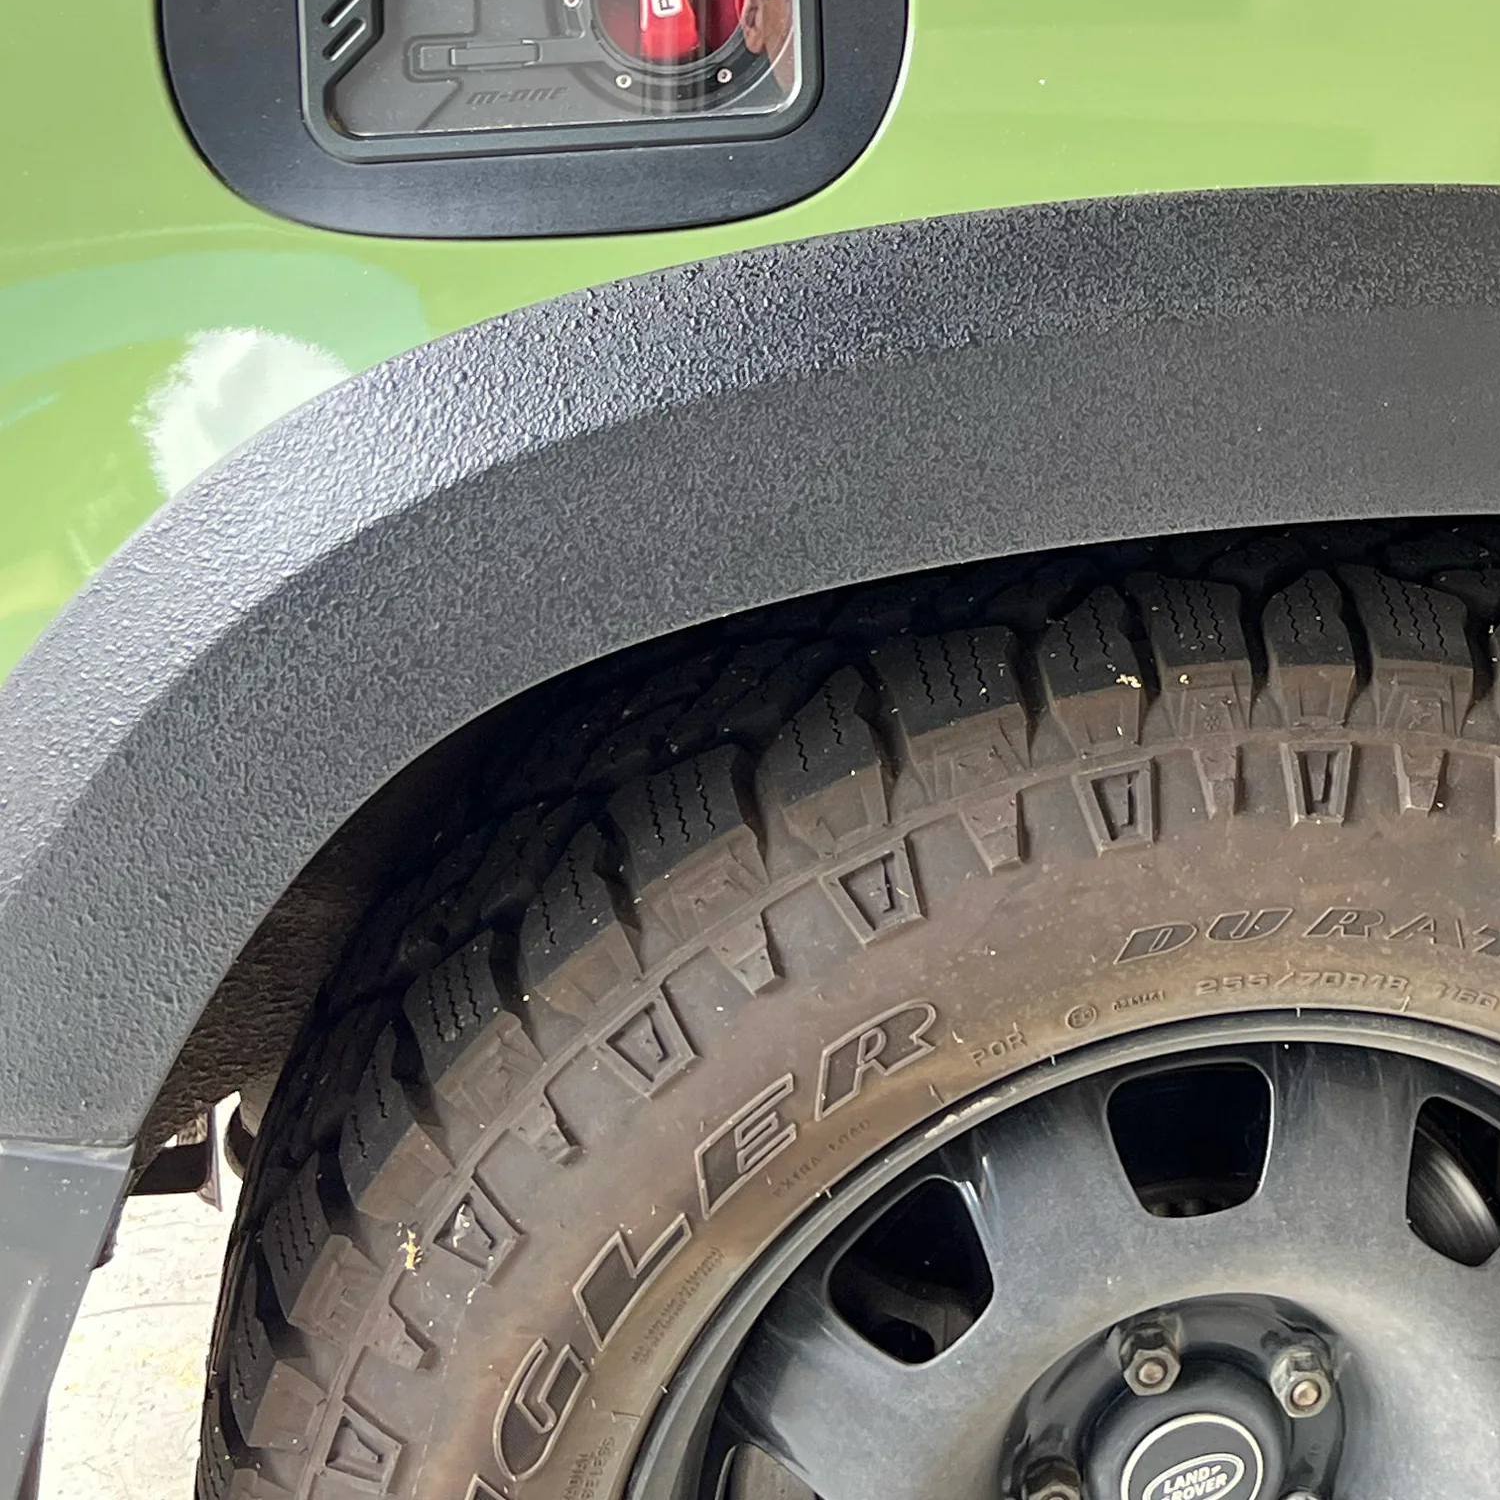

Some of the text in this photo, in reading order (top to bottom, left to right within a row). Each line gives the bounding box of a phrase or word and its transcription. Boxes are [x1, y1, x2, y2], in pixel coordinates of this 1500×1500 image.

[971, 1030, 1029, 1068] POR
[463, 1000, 938, 1500] GLER
[1163, 1465, 1211, 1495] LAND
[1171, 1472, 1228, 1500] ROVER
